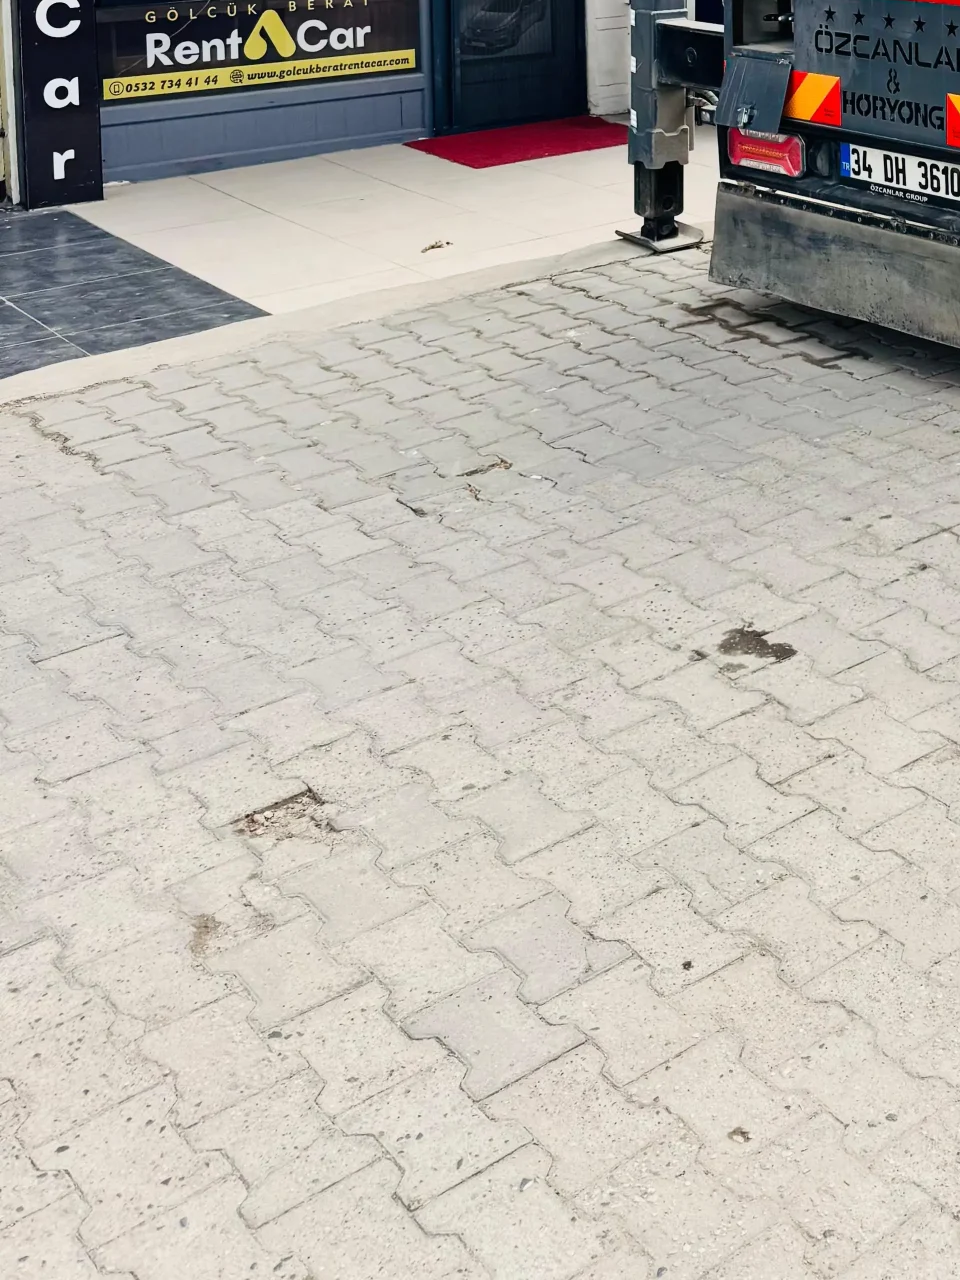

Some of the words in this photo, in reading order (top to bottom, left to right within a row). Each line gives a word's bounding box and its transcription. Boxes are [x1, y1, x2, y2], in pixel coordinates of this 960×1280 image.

[145, 2, 258, 23] GÖLCÜK
[125, 81, 156, 94] 0532
[160, 77, 183, 91] 734
[185, 75, 200, 88] 41
[204, 74, 220, 87] 44
[246, 55, 411, 81] www.golcukberatrentacar.com
[886, 68, 900, 95] &
[842, 90, 945, 131] HORYONG
[842, 161, 851, 171] TR
[850, 148, 874, 180] 34
[882, 153, 907, 187] DH
[869, 183, 905, 199] ÖZCANLAR
[905, 192, 929, 203] GROUP
